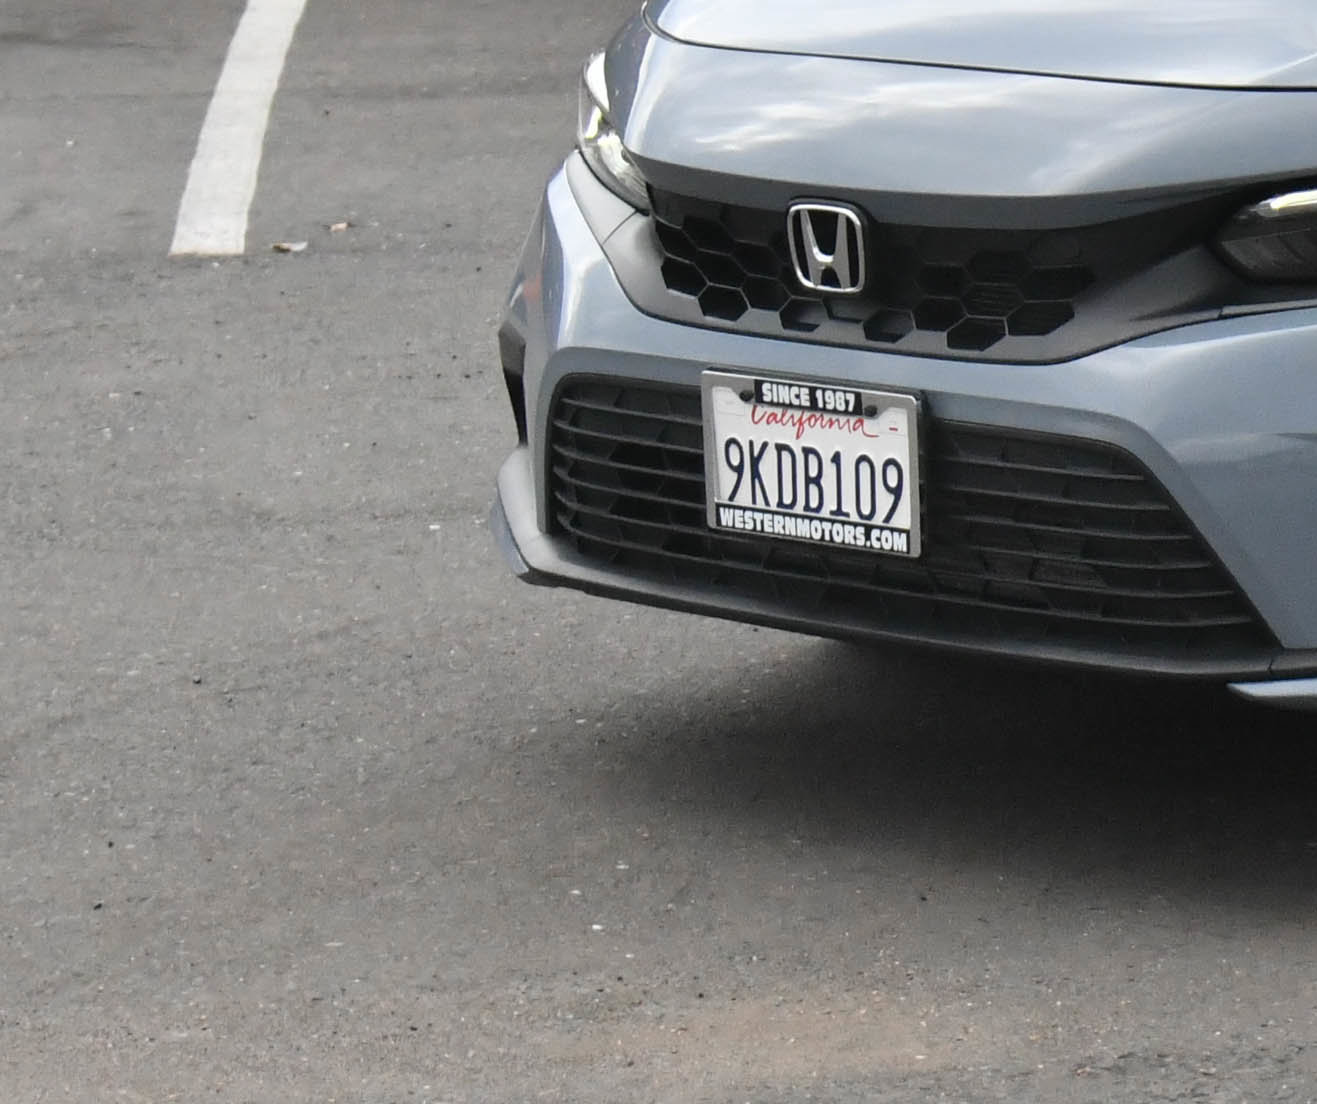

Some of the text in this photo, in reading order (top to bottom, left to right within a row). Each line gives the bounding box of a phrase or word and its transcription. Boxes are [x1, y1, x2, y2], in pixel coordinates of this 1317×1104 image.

[761, 382, 856, 413] SINCE 1987
[724, 436, 904, 524] 9KDB109
[719, 506, 908, 553] WESTERNMOTORS.COM
